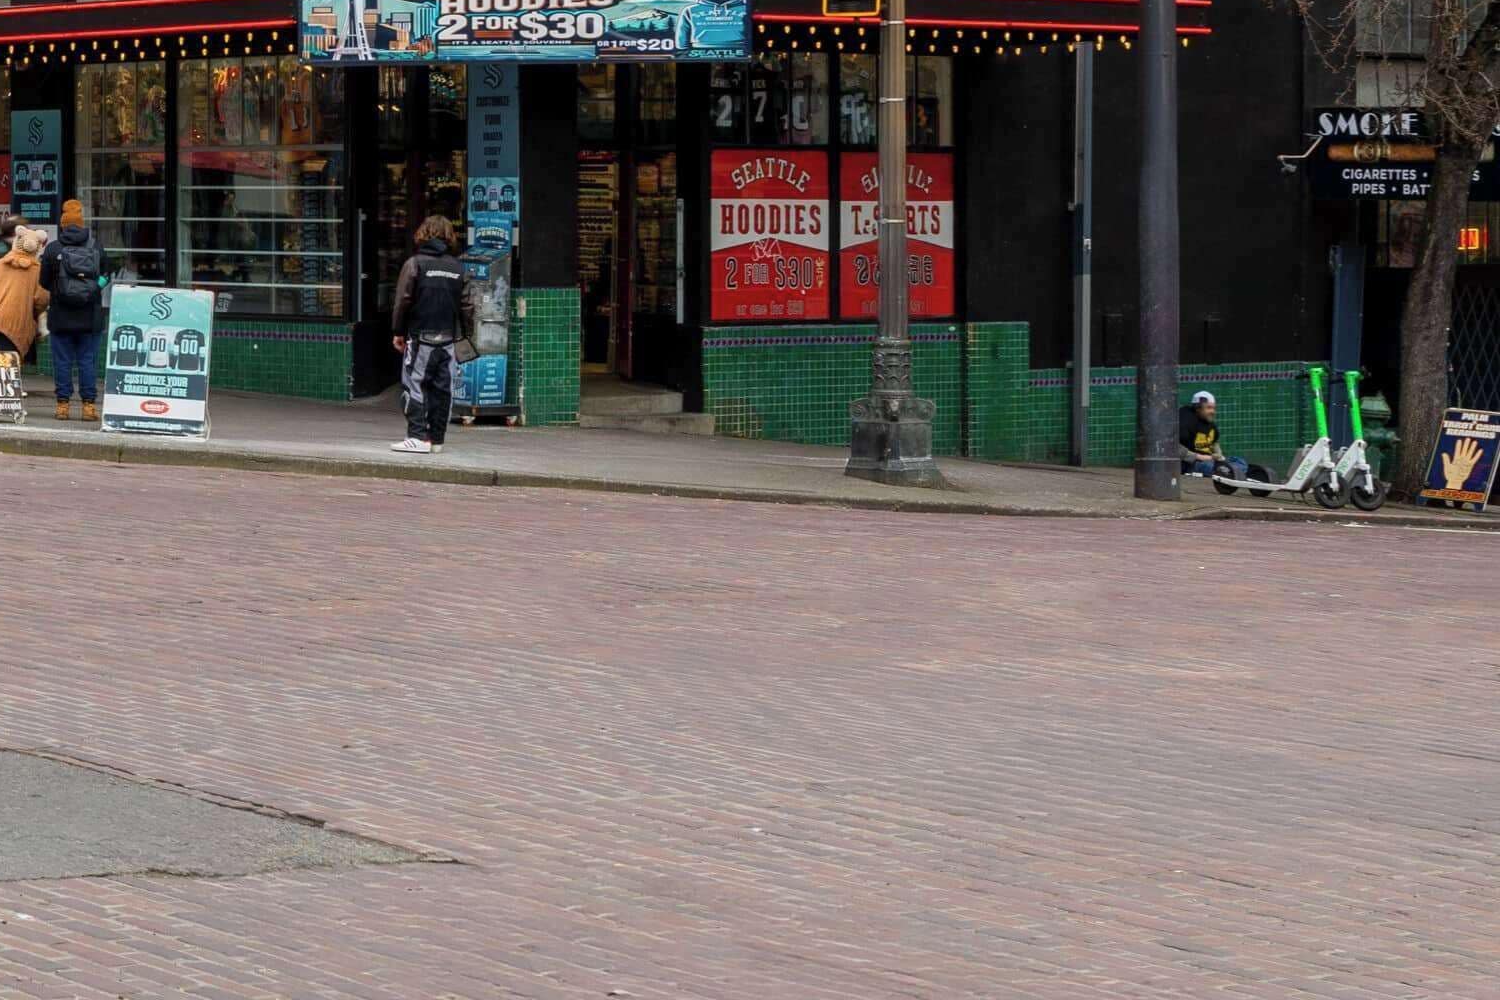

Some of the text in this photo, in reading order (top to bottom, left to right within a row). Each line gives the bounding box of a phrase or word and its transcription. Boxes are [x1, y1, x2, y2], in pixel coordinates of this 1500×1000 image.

[437, 11, 604, 41] 2 FOR $30
[610, 40, 617, 48] 1
[636, 38, 674, 51] $20
[689, 49, 745, 58] SEATTLE
[1318, 113, 1419, 136] SMOKE
[731, 157, 810, 192] SEATTLE
[1342, 168, 1417, 181] CIGARETTES
[1351, 184, 1386, 195] PIPES
[720, 204, 821, 235] HOODIES
[724, 257, 738, 289] 2
[124, 373, 188, 388] CUSTOMIZE YOUR
